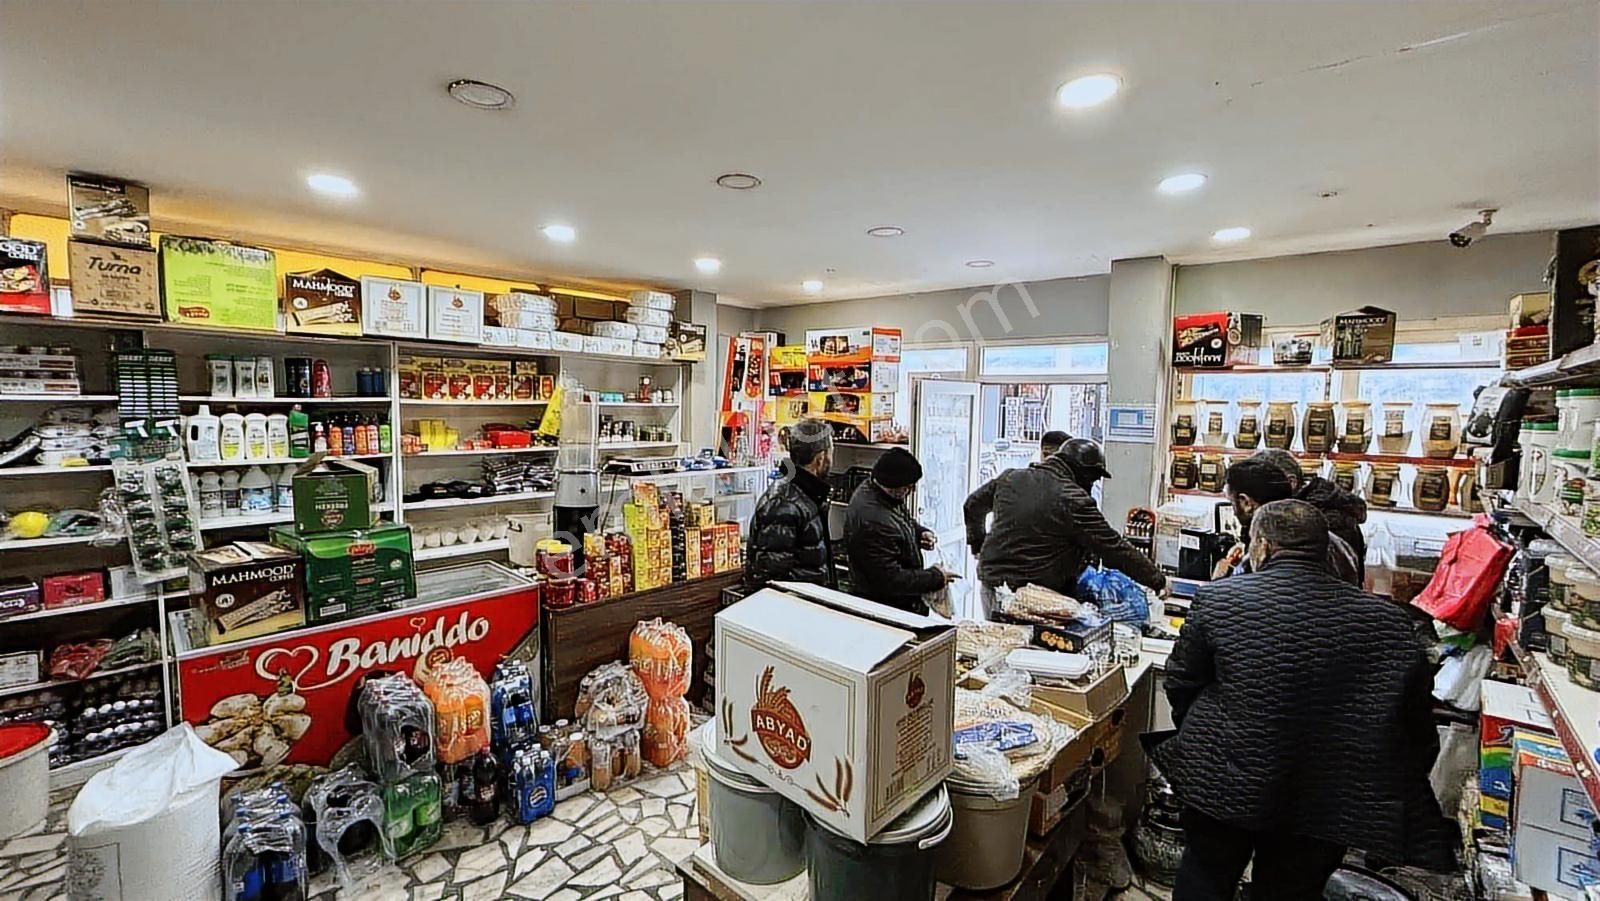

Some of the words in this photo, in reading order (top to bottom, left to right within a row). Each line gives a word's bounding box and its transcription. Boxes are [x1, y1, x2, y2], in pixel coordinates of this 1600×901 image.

[292, 277, 355, 296] MAHMOOD
[212, 564, 296, 587] MAHMOOD
[326, 611, 490, 676] Baniddo
[756, 714, 807, 751] ABYAD
